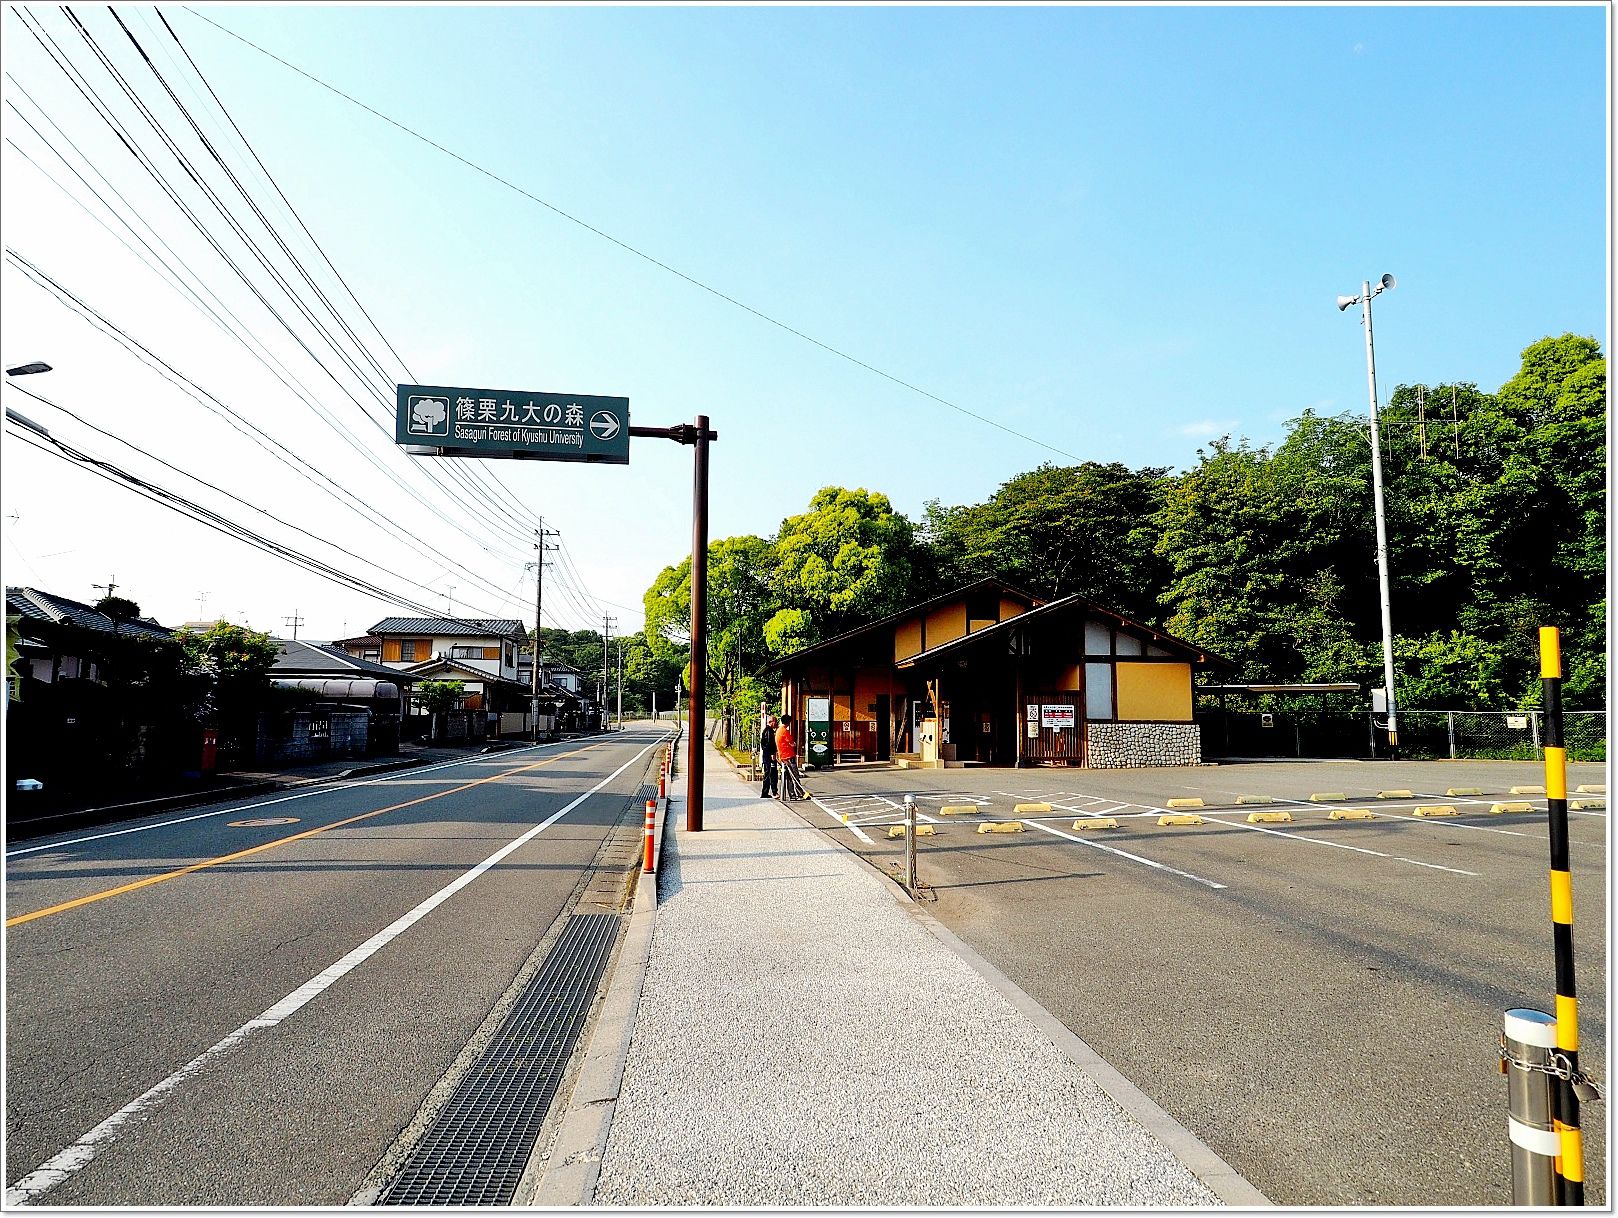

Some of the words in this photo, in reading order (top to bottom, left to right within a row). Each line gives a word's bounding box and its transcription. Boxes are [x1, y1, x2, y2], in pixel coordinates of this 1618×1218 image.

[455, 396, 584, 426] 篠栗九大の森
[455, 425, 487, 443] Sasaguri
[488, 427, 511, 442] Forest
[512, 428, 520, 442] of
[521, 429, 548, 445] Kyushu
[549, 430, 583, 448] University
